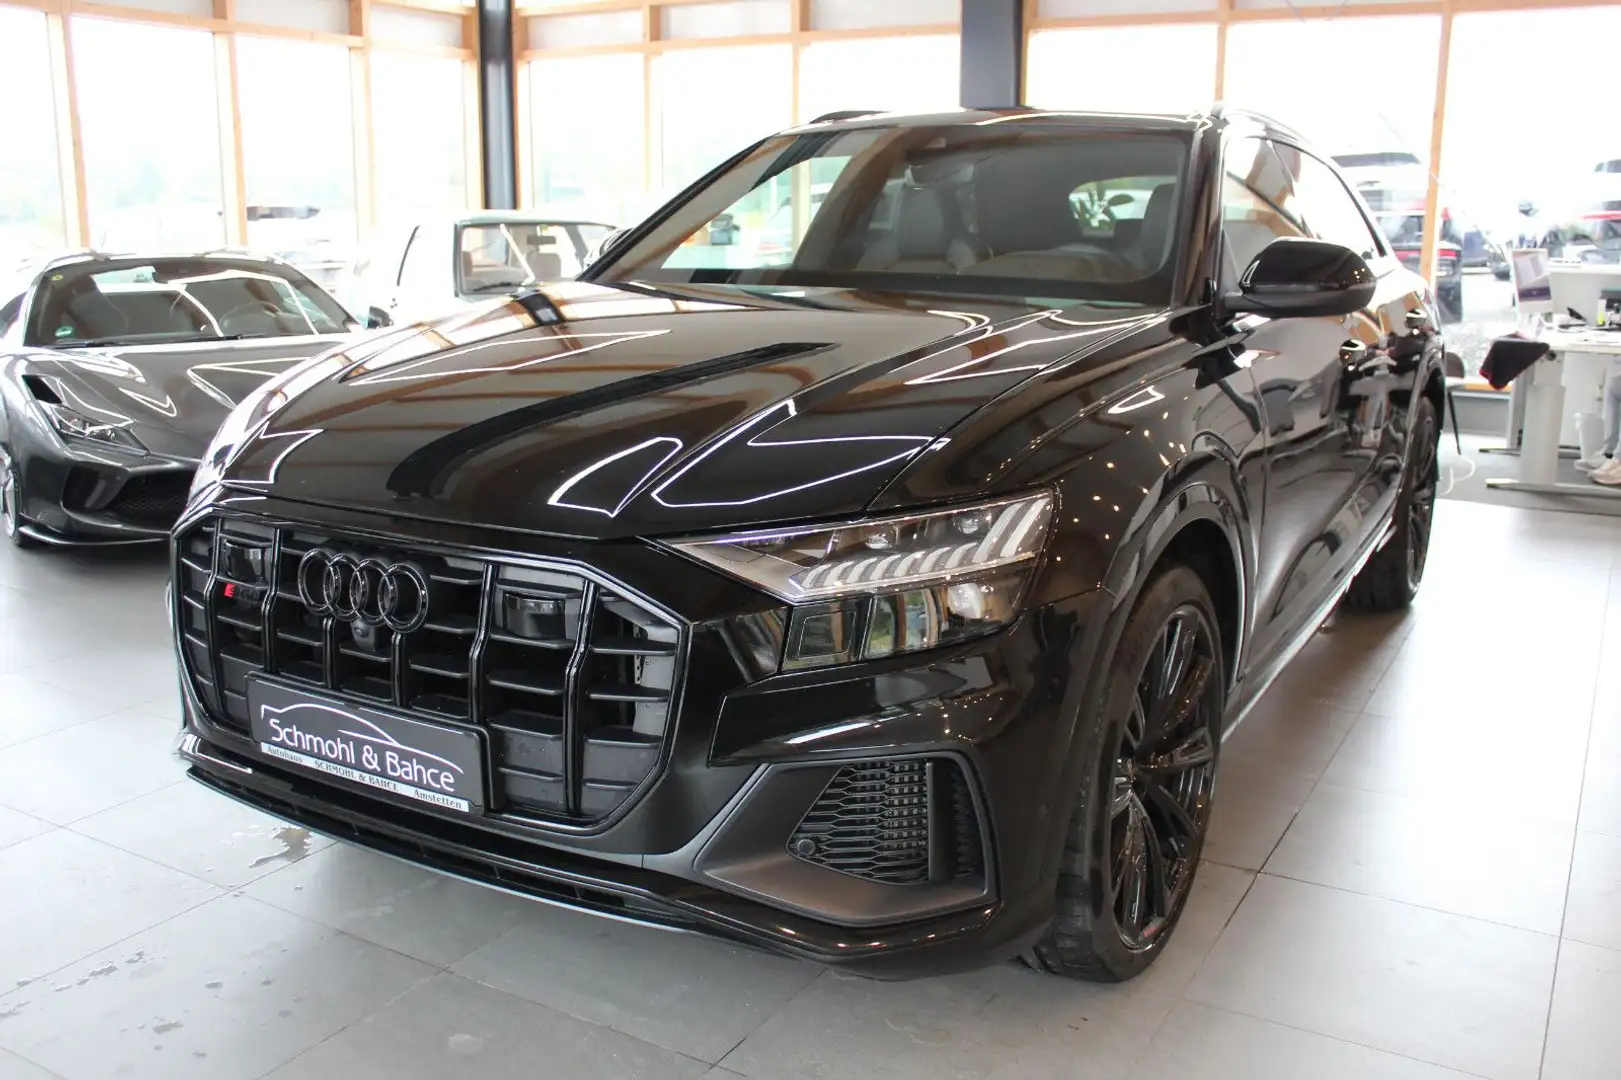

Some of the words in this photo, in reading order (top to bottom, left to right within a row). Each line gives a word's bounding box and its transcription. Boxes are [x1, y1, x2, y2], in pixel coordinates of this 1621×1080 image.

[266, 746, 303, 763] Autohaus
[314, 759, 356, 780] SCHMOHL
[358, 771, 367, 782] &
[368, 774, 400, 792] BAHCE
[413, 788, 462, 809] Amstetten
[269, 718, 355, 764] Schmohl
[361, 744, 381, 773] &
[385, 750, 455, 792] Bahce
